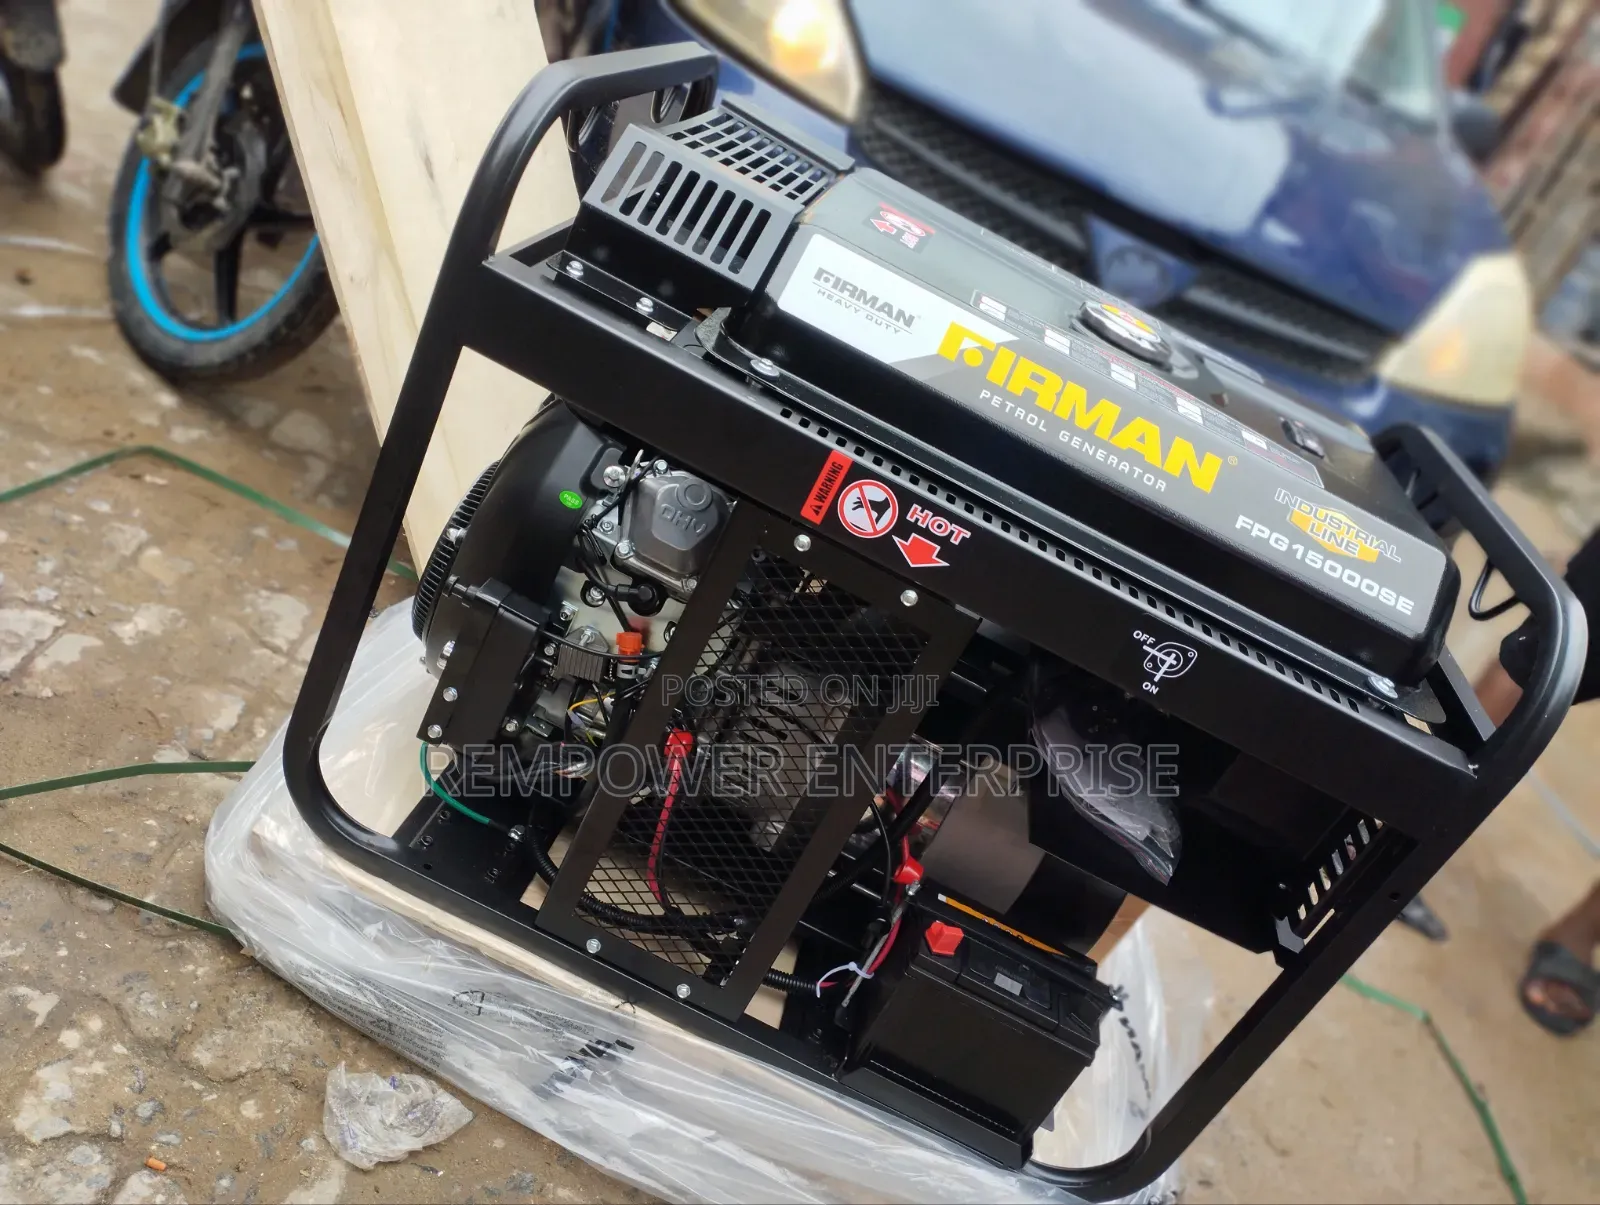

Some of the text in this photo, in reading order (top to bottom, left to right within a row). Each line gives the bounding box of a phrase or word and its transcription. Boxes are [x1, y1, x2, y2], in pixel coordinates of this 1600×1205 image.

[813, 266, 916, 329] FIRMAN
[817, 288, 901, 335] HEAVY DUTY
[936, 320, 1223, 494] FIRMAN
[979, 389, 1168, 493] PETROL GENERATOR
[563, 493, 580, 506] PASS
[813, 461, 844, 504] WARNING
[906, 503, 971, 546] HOT
[1274, 487, 1402, 563] INDUSTRIAL
[1307, 522, 1360, 558] LINE
[1235, 514, 1415, 616] FPG15000SE
[1133, 630, 1156, 645] OFF
[1142, 681, 1159, 695] ON
